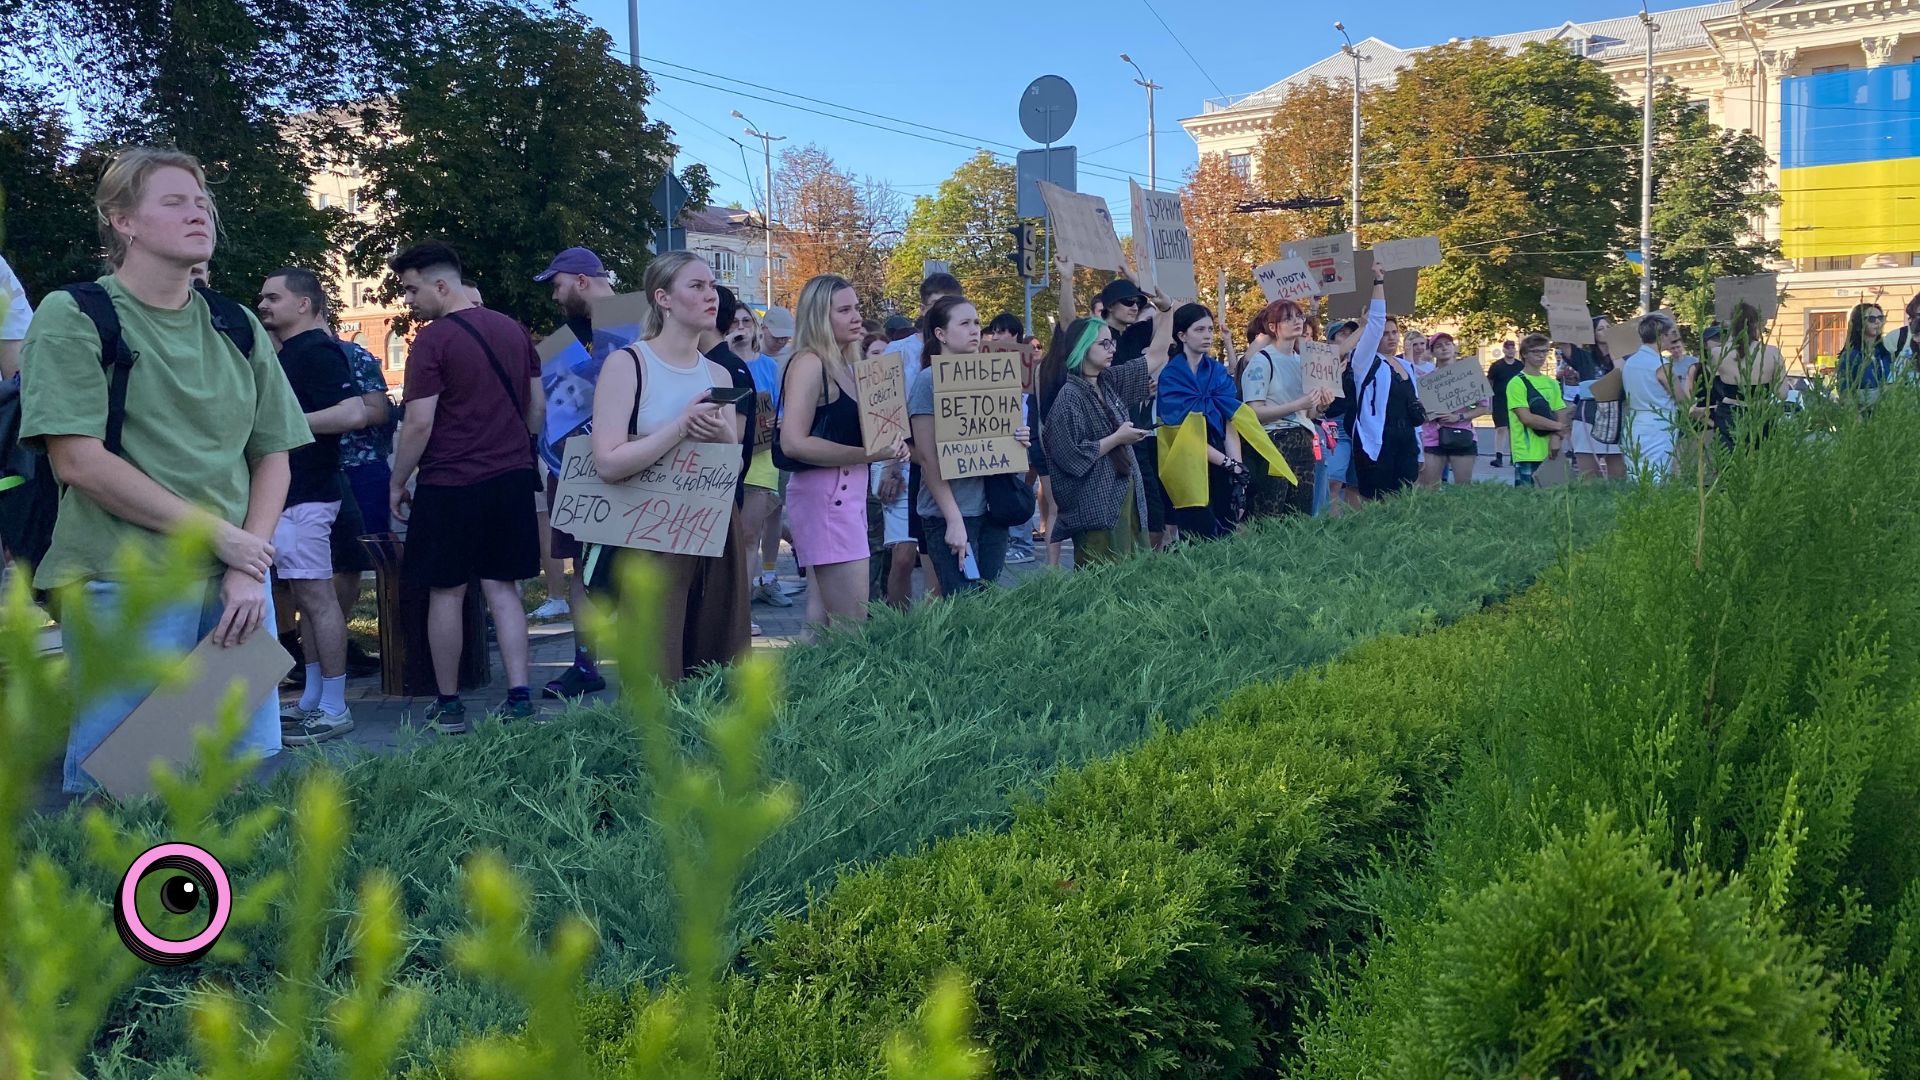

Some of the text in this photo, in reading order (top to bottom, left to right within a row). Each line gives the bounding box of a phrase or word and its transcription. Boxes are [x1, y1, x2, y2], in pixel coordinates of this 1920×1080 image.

[1259, 269, 1276, 283] МИ
[1276, 271, 1307, 287] ПРОТИ
[1278, 281, 1311, 299] 12414
[940, 359, 1016, 383] ГАНЬБА
[941, 395, 1021, 418] ВЕТО НА
[958, 417, 1011, 436] ЗАКОН
[942, 443, 978, 457] ЛЮДИ
[671, 448, 701, 475] НЕ
[957, 453, 1010, 474] ВЛАДА
[554, 495, 722, 553] ВЕТО 12414
